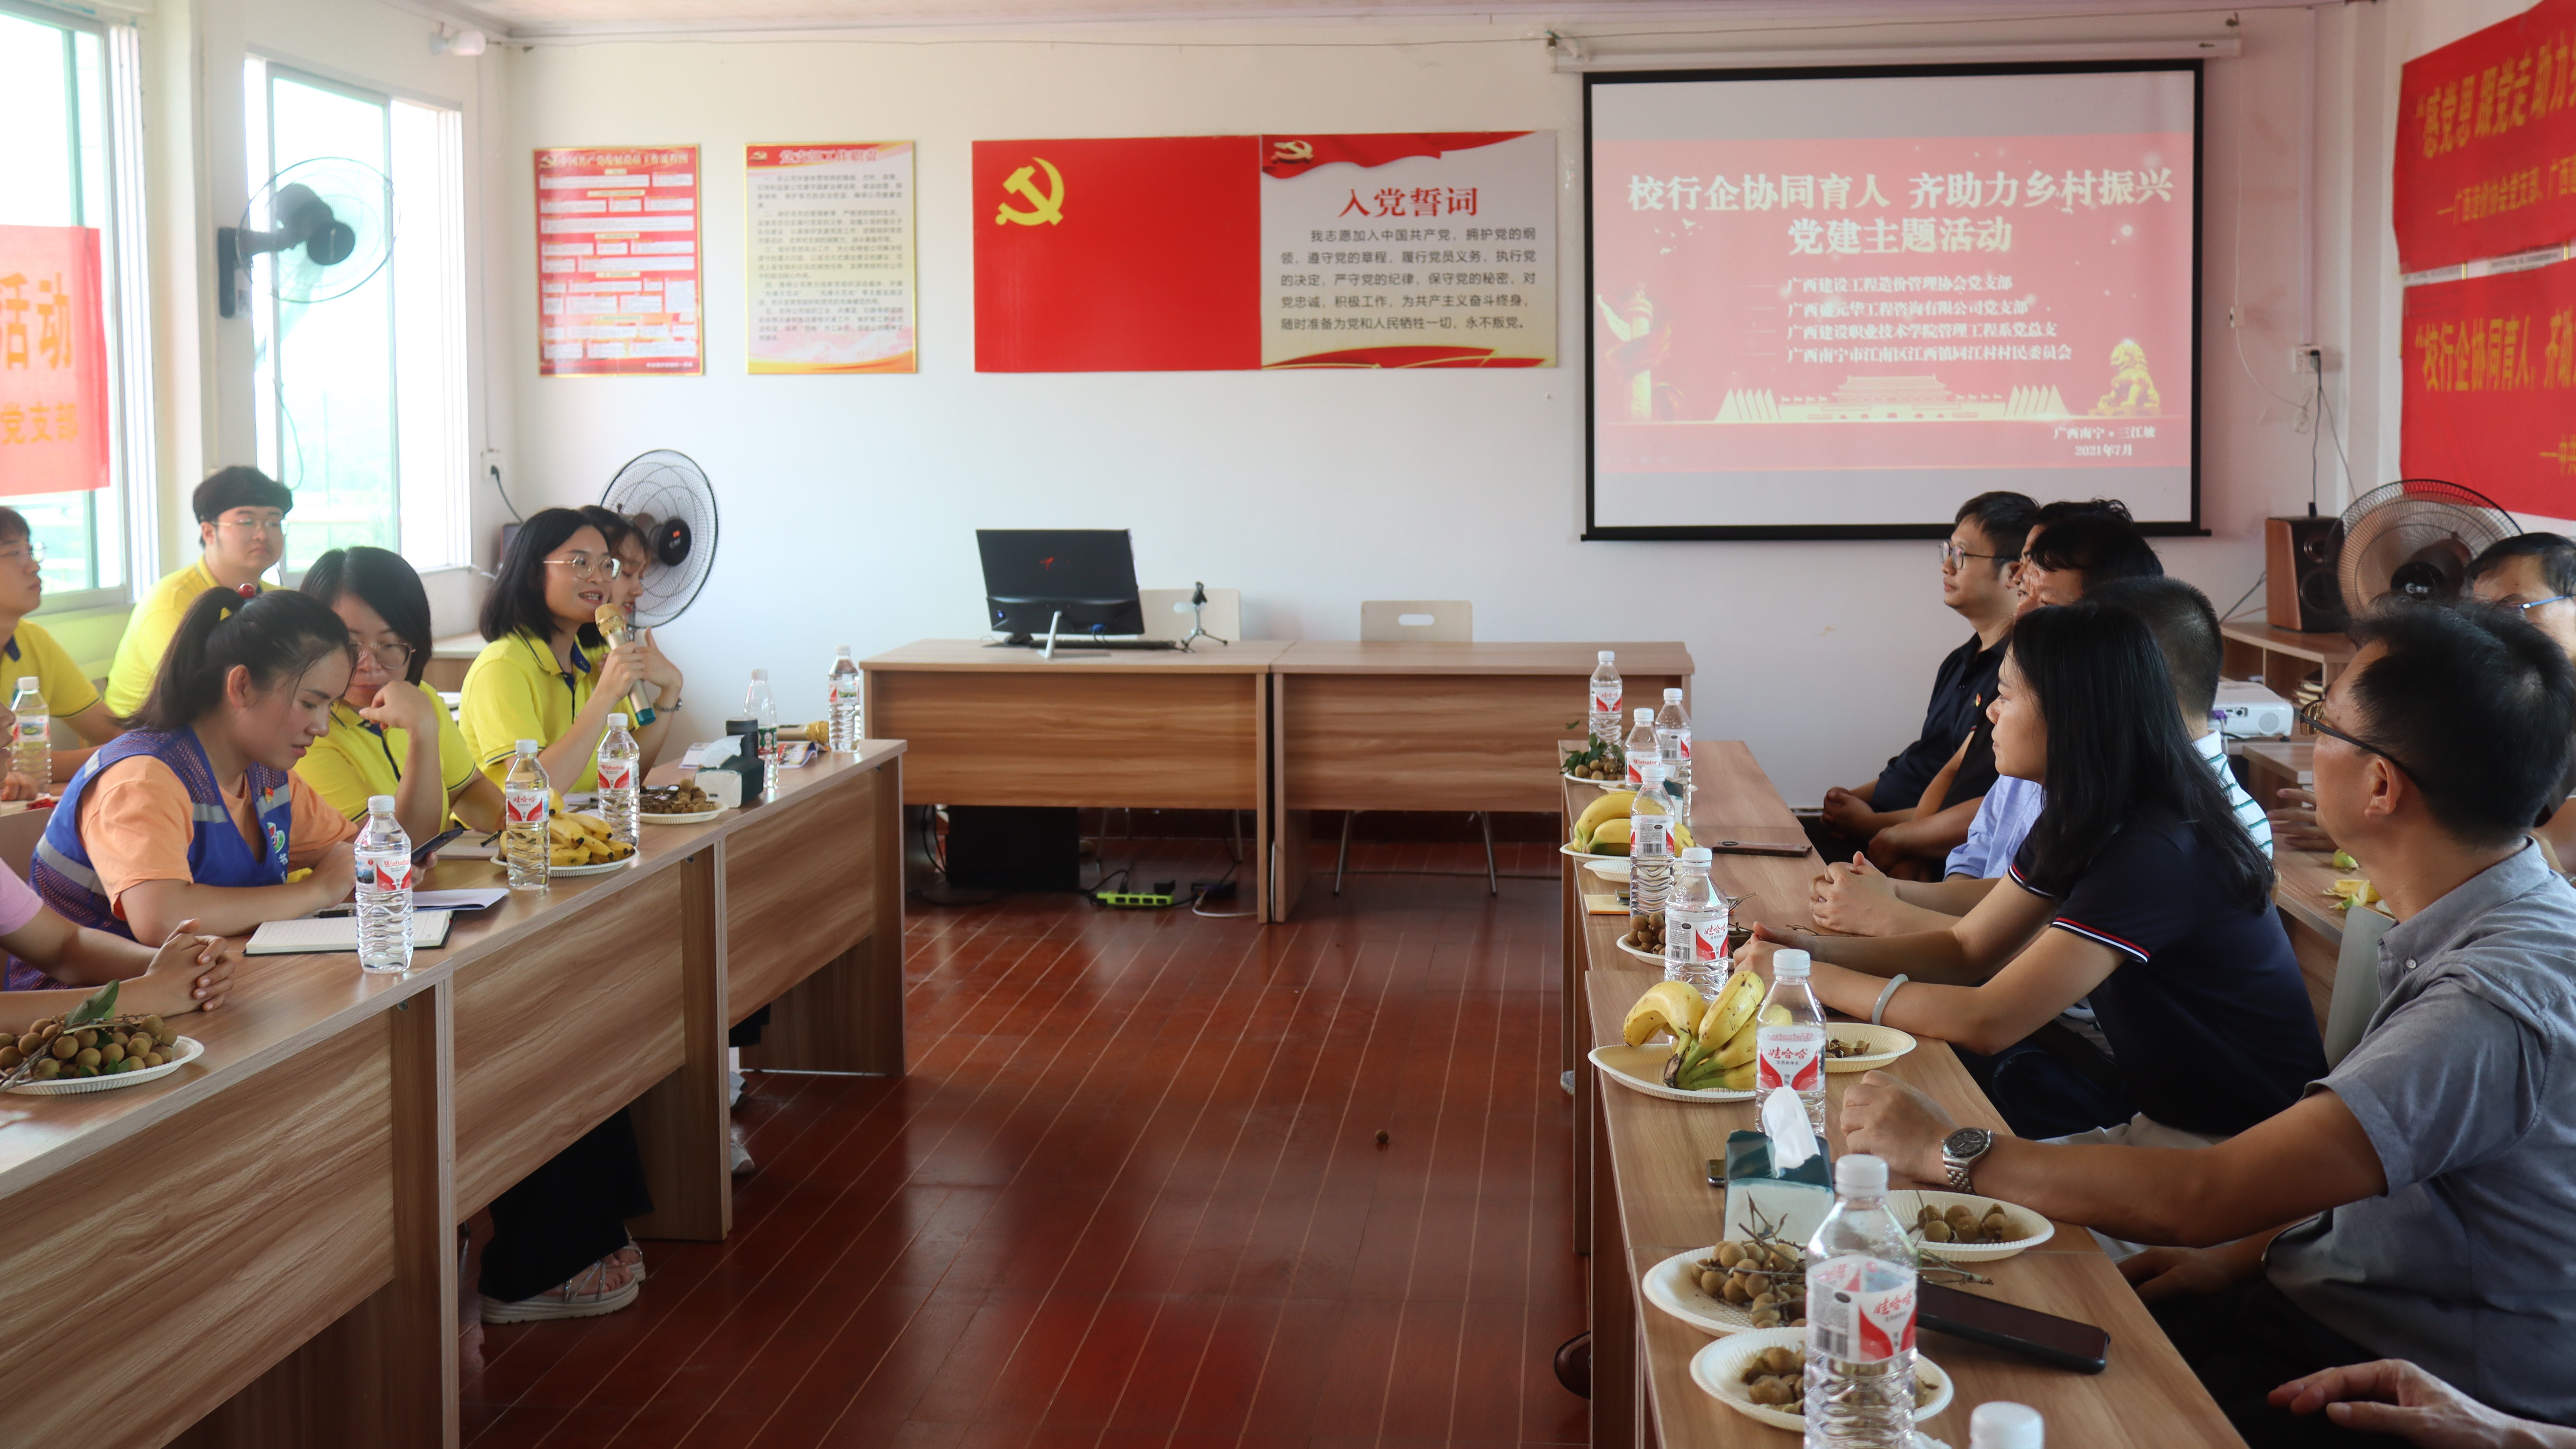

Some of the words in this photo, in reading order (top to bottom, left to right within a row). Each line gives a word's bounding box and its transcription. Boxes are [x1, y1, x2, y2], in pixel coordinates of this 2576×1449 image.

[1338, 187, 1478, 218] 入党誓词
[1628, 173, 1891, 211] 校行企协同育人
[1908, 168, 2173, 209] 齐助力乡村振兴
[1788, 216, 2013, 255] 党建主题活动
[1787, 275, 2013, 293] 广西建设工程造价管理协会党支部
[1, 400, 78, 445] 党支部
[1768, 1046, 1807, 1059] 娃哈哈
[1873, 1289, 1913, 1315] 娃哈哈
